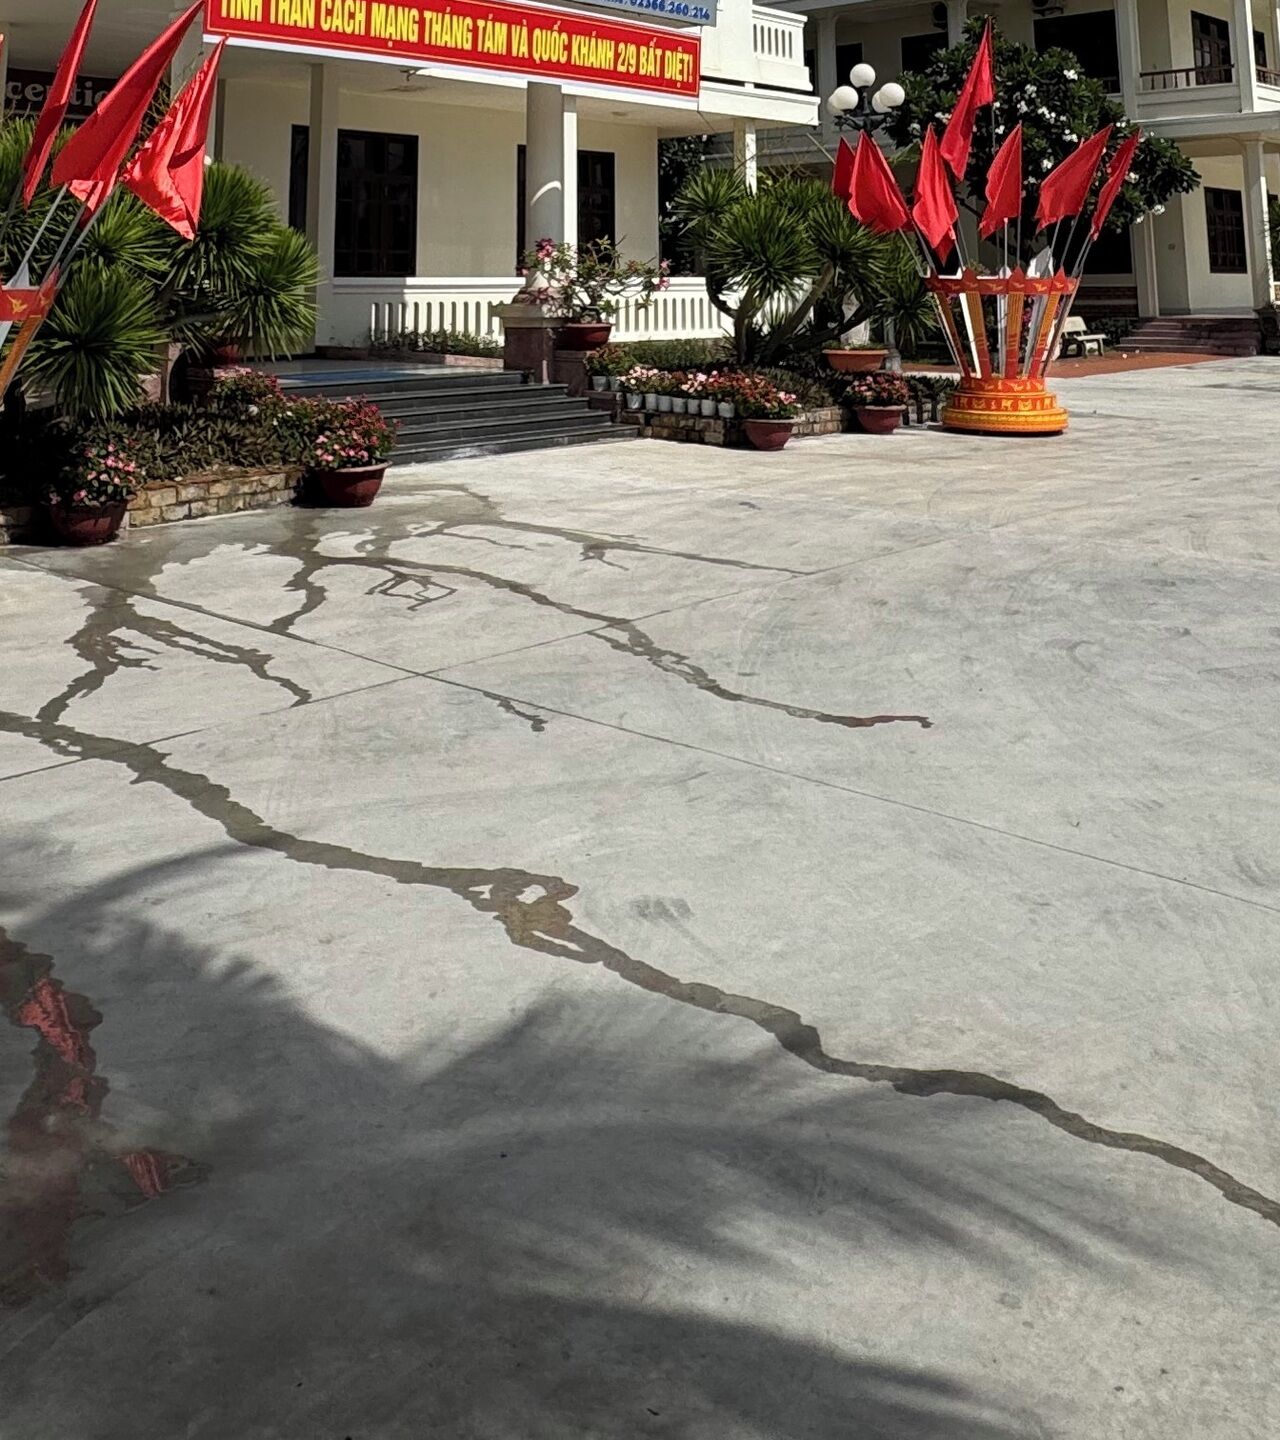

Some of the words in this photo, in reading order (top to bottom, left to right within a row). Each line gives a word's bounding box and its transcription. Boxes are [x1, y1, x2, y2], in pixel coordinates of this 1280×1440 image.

[371, 2, 419, 48] MẠNG
[424, 6, 473, 51] THÁNG
[477, 14, 507, 56] TÁM
[511, 19, 529, 59] VÀ
[532, 21, 569, 64] QUỐC
[571, 30, 615, 70] KHÁNH
[617, 42, 636, 75] 2/9
[639, 38, 662, 77] BẤT
[664, 46, 693, 88] DIỆT!
